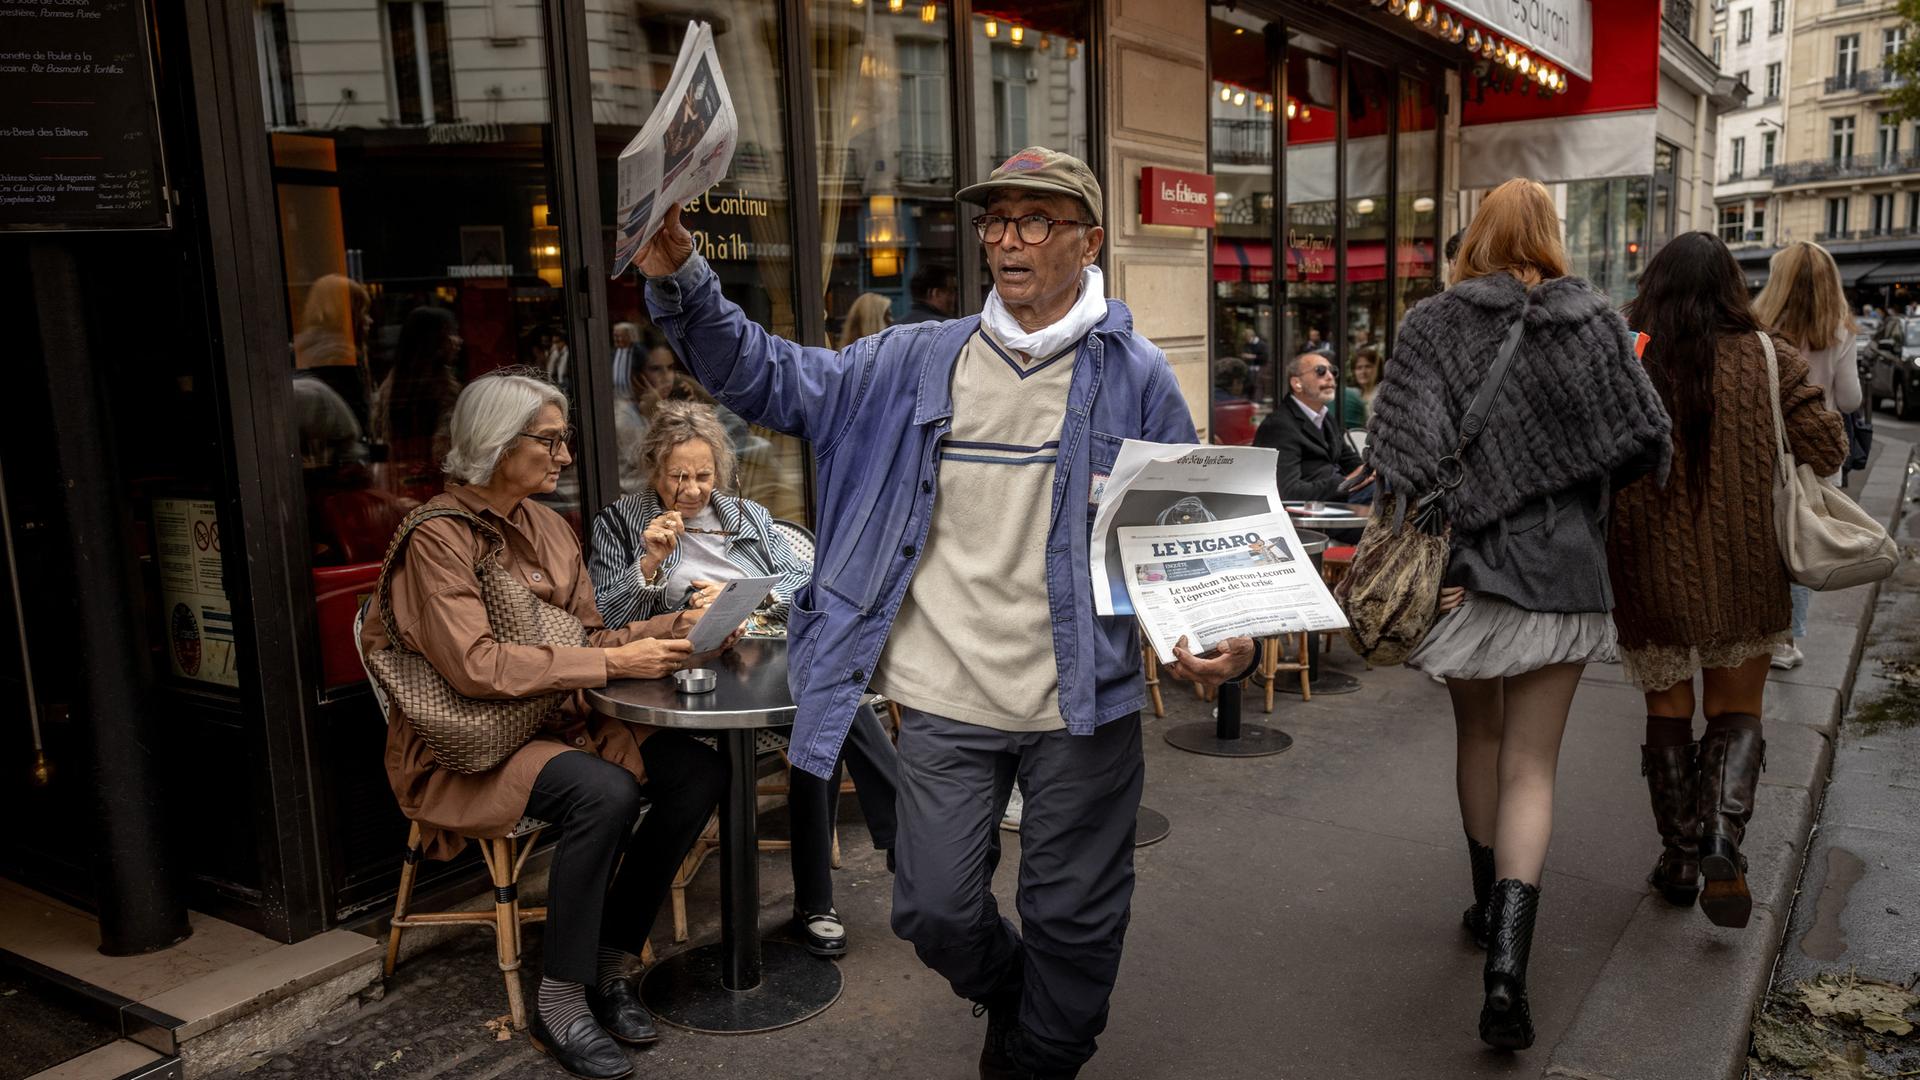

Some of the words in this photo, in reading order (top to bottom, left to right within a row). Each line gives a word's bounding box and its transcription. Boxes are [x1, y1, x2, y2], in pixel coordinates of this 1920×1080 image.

[40, 8, 74, 18] Pommes
[76, 8, 101, 19] Purée
[33, 51, 45, 61] de
[47, 51, 72, 61] Poulet
[83, 51, 92, 61] la
[31, 63, 44, 73] Riz
[46, 63, 81, 73] Basmati
[83, 64, 91, 74] &
[94, 64, 124, 74] Tortillas
[37, 127, 54, 137] des
[705, 183, 767, 216] Continu
[1188, 455, 1203, 465] New
[1203, 455, 1217, 467] York
[1217, 455, 1234, 465] Times
[1152, 542, 1178, 557] LE
[1179, 532, 1261, 555] FIGARO
[1168, 586, 1182, 596] Le
[1182, 579, 1220, 593] tandem
[1220, 567, 1296, 583] Macron-Lecornu
[1173, 596, 1181, 605] à
[1228, 581, 1240, 591] de
[1241, 579, 1251, 588] la
[1251, 578, 1274, 587] crise
